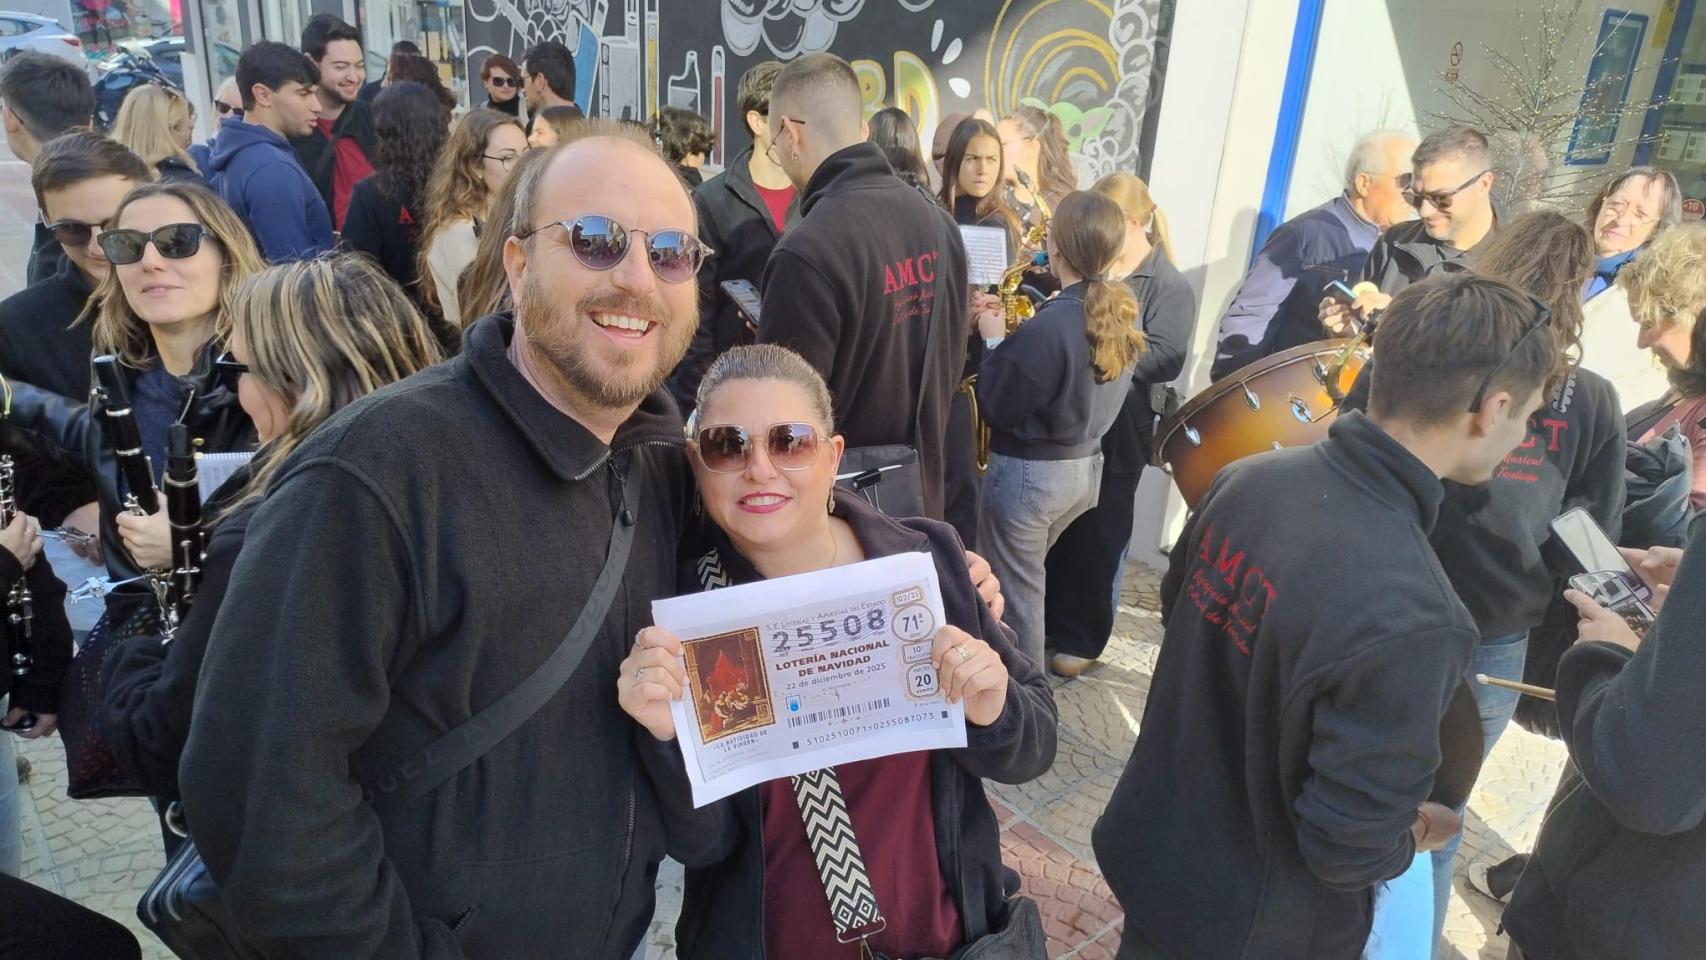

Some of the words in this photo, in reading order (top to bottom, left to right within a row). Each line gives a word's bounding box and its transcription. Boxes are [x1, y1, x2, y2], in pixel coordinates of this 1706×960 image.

[772, 609, 886, 653] 25508
[776, 654, 827, 671] LOTERÍA
[830, 640, 890, 660] NACIONAL
[798, 668, 814, 677] DE
[818, 655, 871, 673] NAVIDAD
[798, 680, 809, 688] de
[812, 671, 852, 685] diciembre
[854, 667, 864, 676] de
[867, 663, 886, 673] 2025
[915, 674, 931, 687] 20
